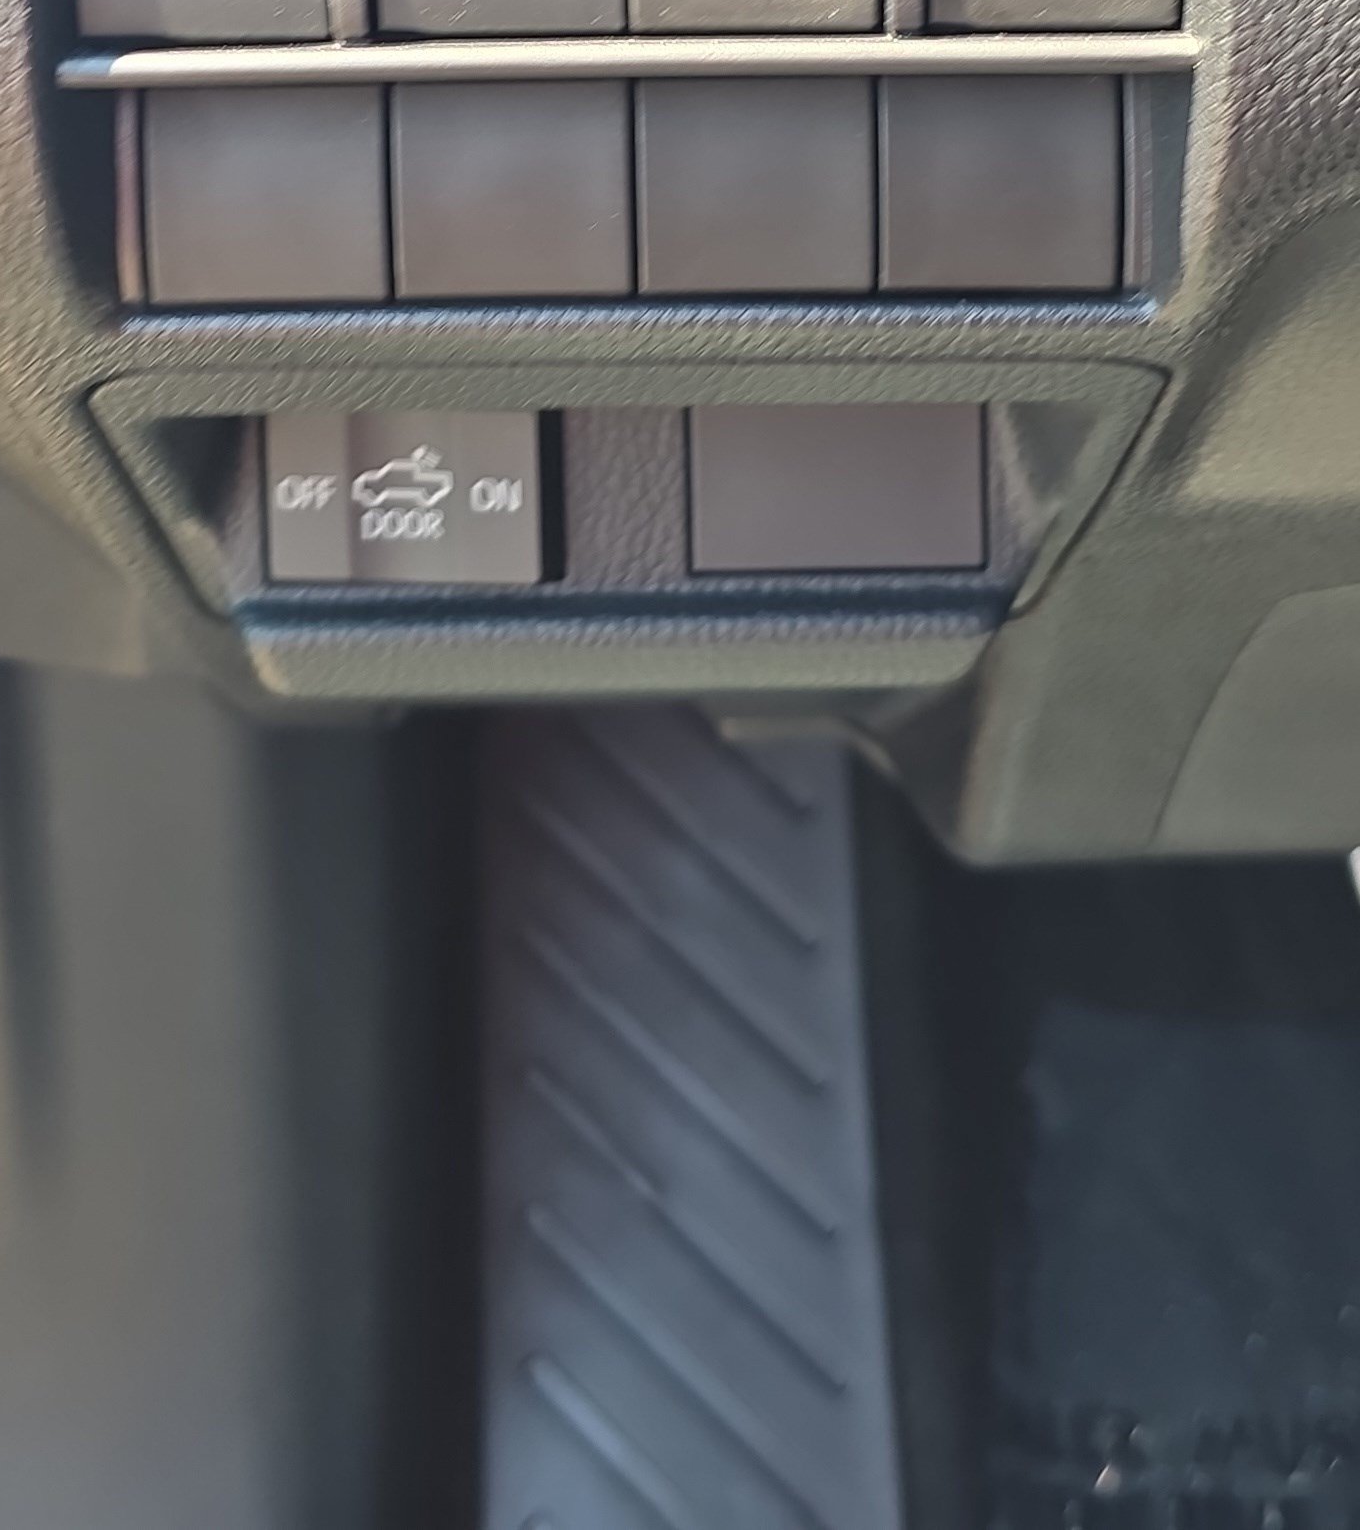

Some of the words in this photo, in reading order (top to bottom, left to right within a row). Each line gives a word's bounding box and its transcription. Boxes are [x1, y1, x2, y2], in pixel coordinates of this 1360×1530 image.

[275, 475, 337, 509] OFF
[470, 477, 523, 512] ON
[360, 508, 444, 541] DOOR
